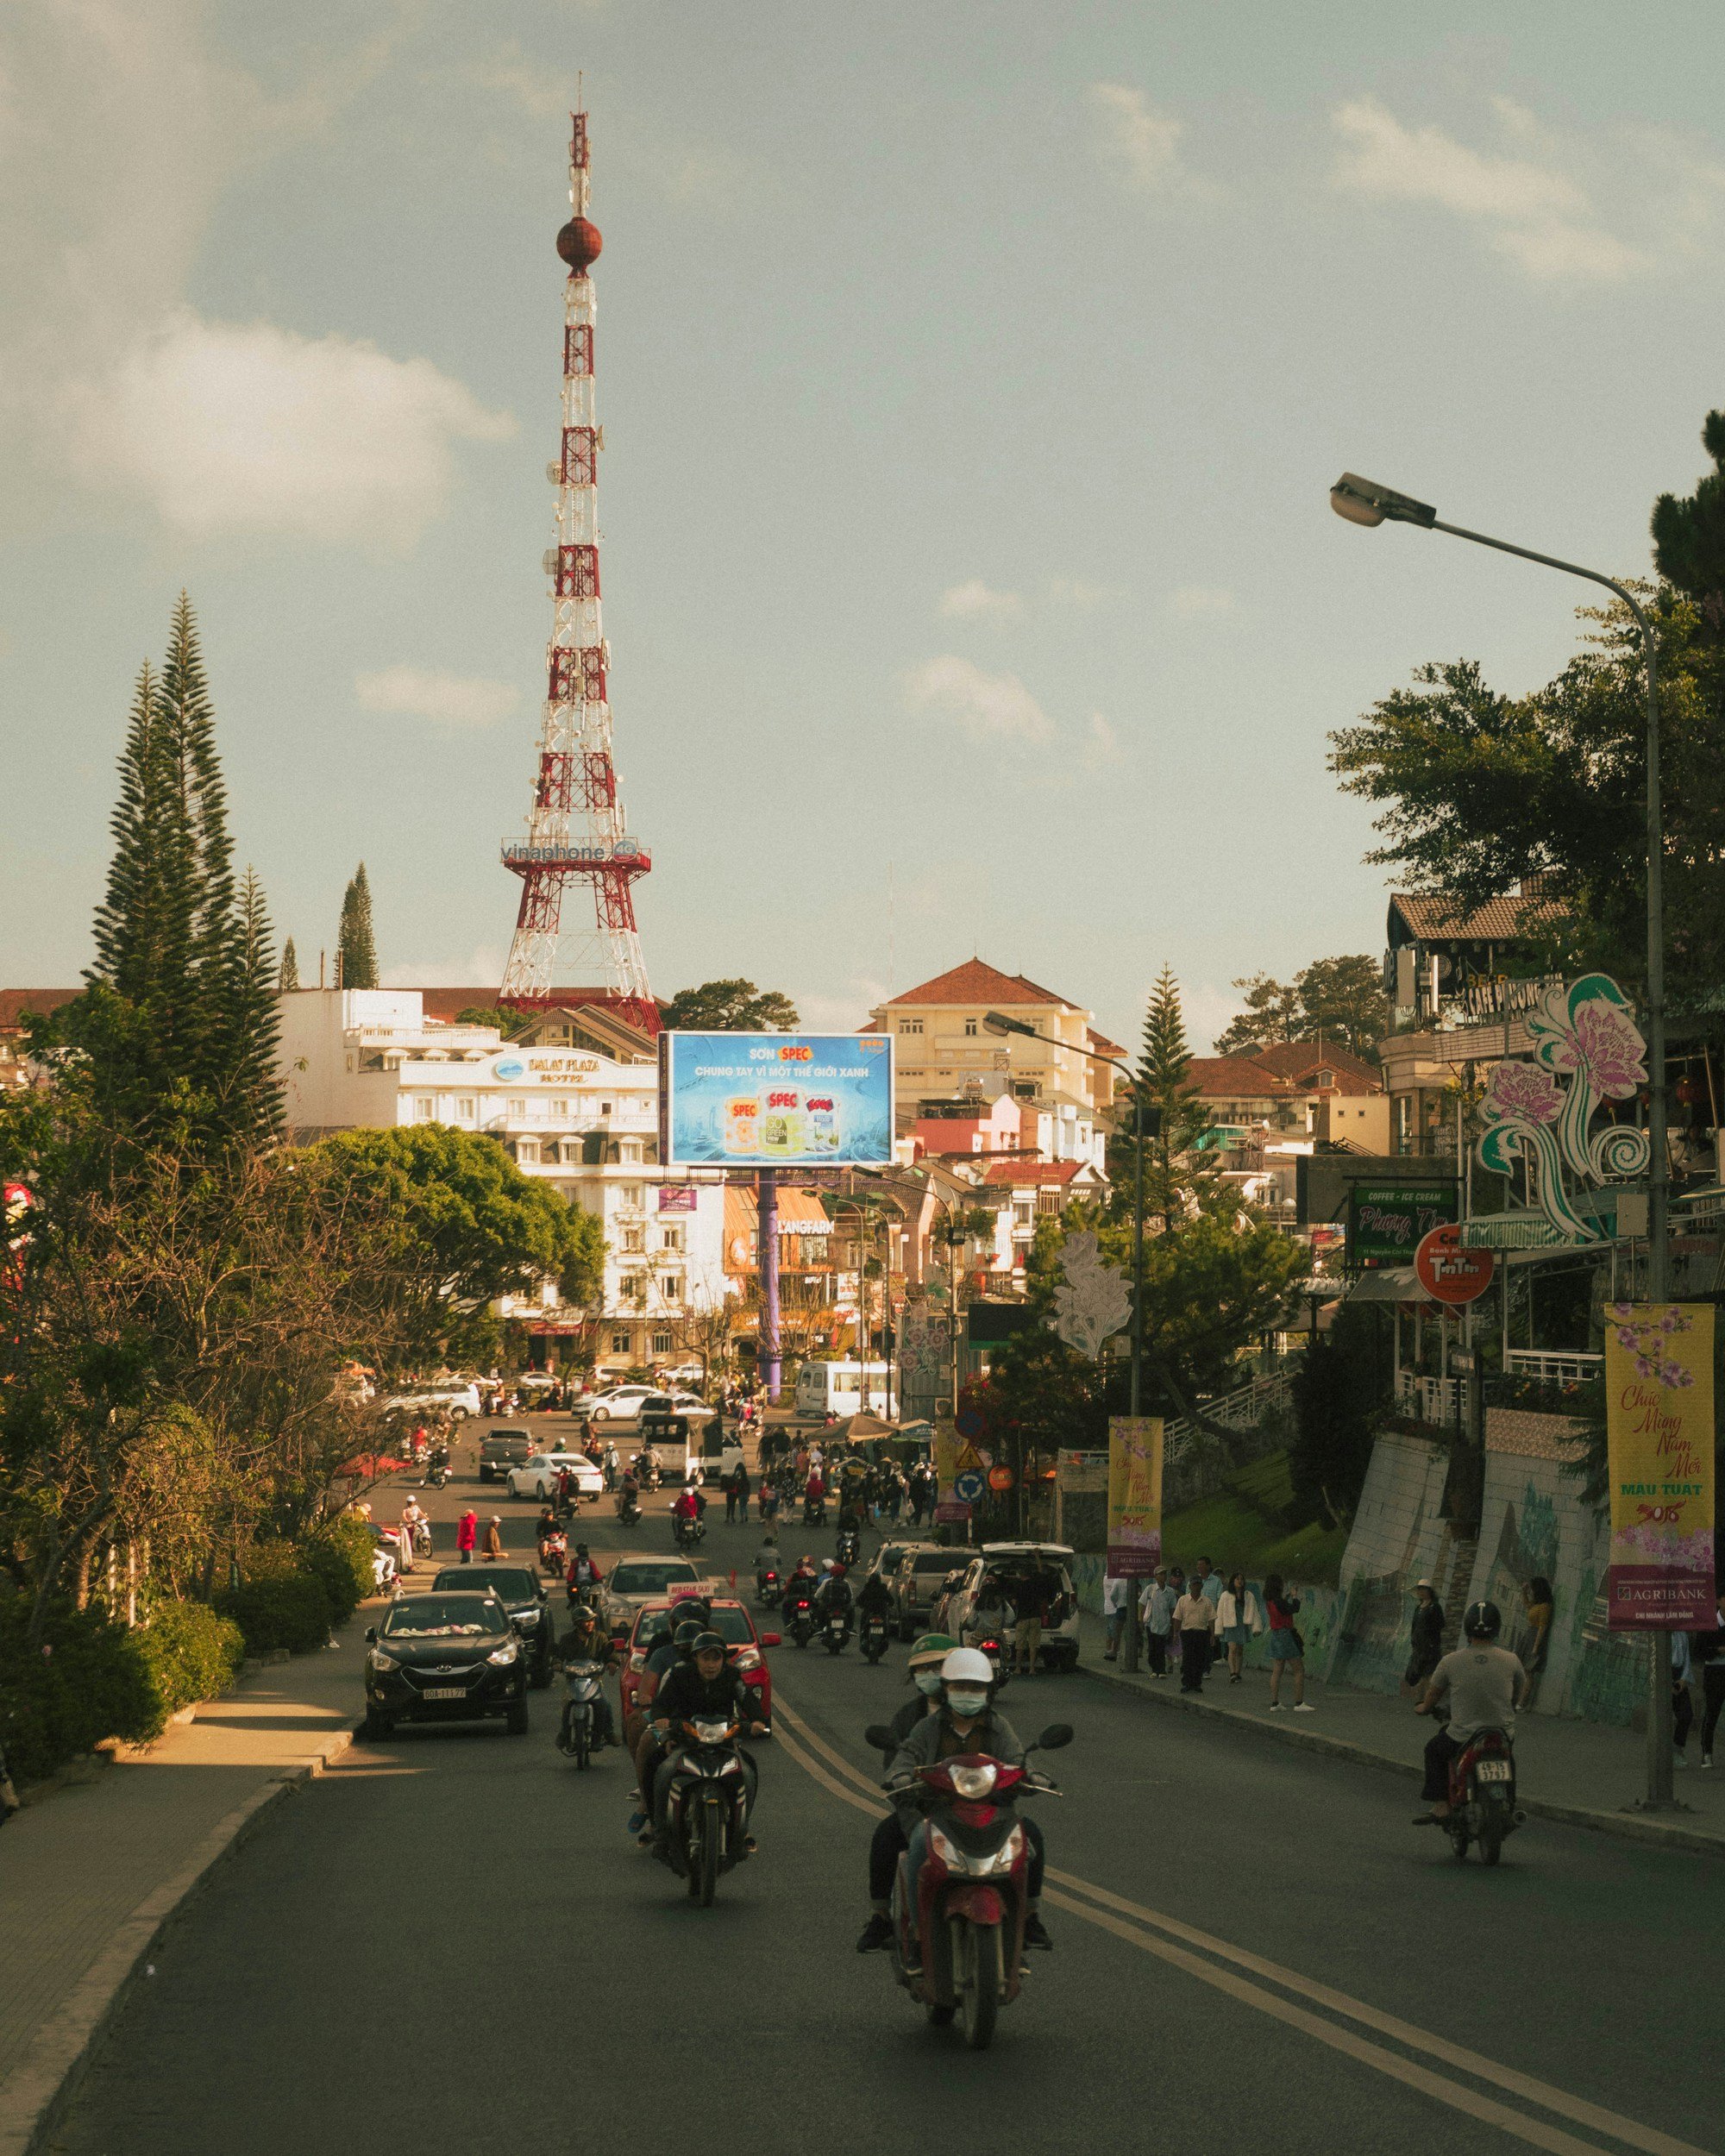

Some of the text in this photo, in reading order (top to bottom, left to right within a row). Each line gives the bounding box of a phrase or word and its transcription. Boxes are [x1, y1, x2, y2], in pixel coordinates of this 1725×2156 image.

[500, 843, 633, 863] vinaphone 4G
[750, 1045, 808, 1061] SƠN SPEC
[529, 1058, 600, 1072] DALAT PLAZA
[694, 1063, 869, 1078] CHUNG TAY VÌ MỘT THẾ GIỚI XANH
[540, 1074, 588, 1083] HOTEL
[768, 1092, 798, 1108] SPEC
[733, 1104, 756, 1117] SPEC
[767, 1117, 782, 1129] GO
[1621, 1384, 1661, 1411] Chúc
[1665, 1452, 1702, 1479] Mới
[1634, 1589, 1707, 1601] AGRIBANK
